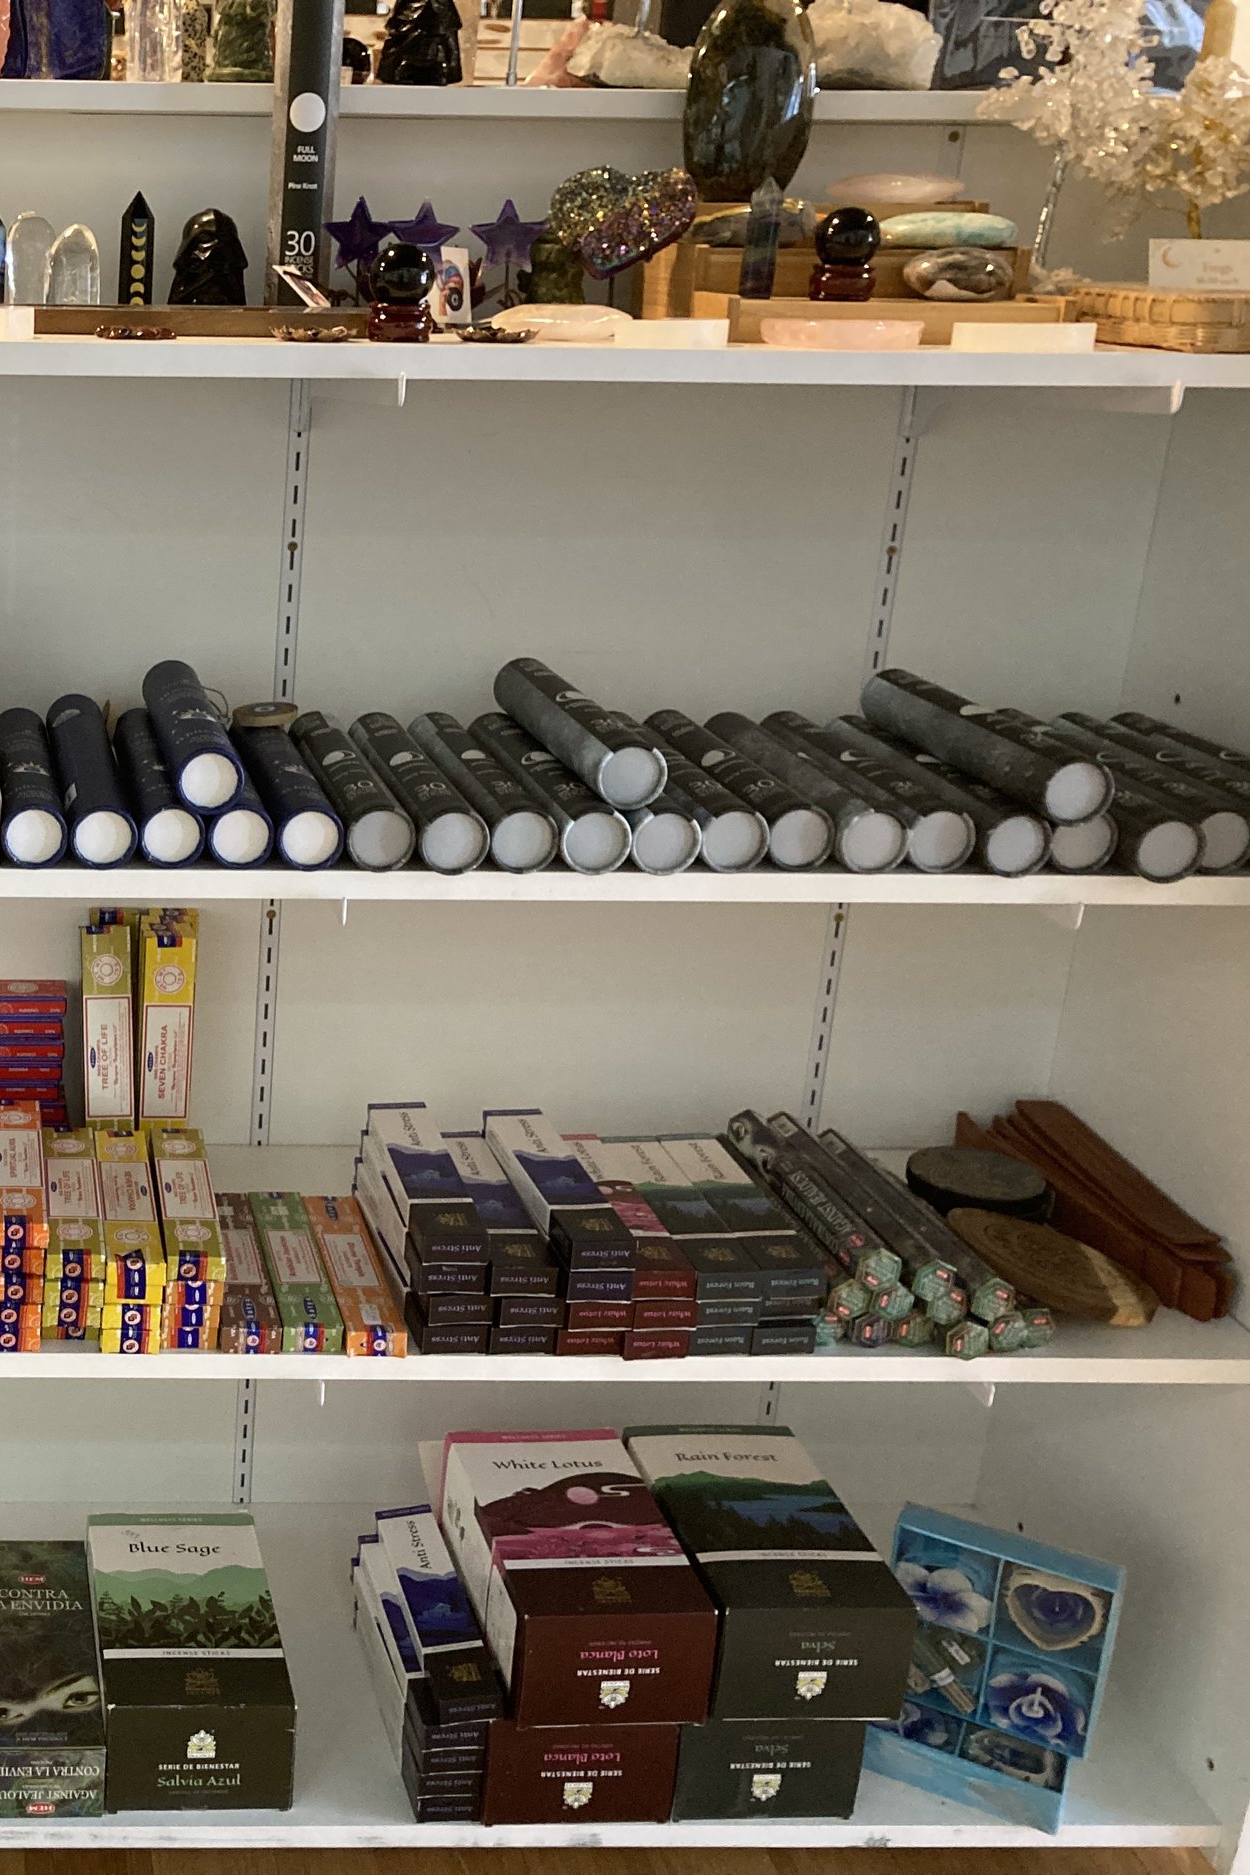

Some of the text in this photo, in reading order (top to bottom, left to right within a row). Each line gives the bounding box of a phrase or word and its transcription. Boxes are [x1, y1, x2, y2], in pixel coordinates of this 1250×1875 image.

[296, 145, 315, 154] FULL
[292, 154, 319, 163] MOON
[284, 230, 316, 256] 30
[100, 1023, 109, 1090] TREE OF LIFE
[158, 1024, 168, 1100] SEVEN CHAKRA
[431, 1244, 483, 1253] Anti Stress
[580, 1249, 631, 1258] Anti Stress
[576, 1281, 627, 1290] Anti Stress
[639, 1279, 688, 1288] White Lotus
[674, 1451, 779, 1463] Rain Forest
[493, 1458, 603, 1471] White Lotus
[128, 1541, 222, 1557] Blue Sage
[406, 1520, 432, 1570] Anti Stress
[19, 1575, 45, 1583] HEM
[10, 1599, 84, 1611] ENVIDIA
[801, 1640, 837, 1653] Selva
[162, 1649, 231, 1657] INCENSE STICKS
[580, 1649, 659, 1663] Loto Blanca
[576, 1666, 660, 1677] SERIE DE BIENESTAR
[543, 1752, 621, 1766] Loto Blanca
[34, 1766, 52, 1777] LA
[53, 1766, 100, 1777] CONTRA
[158, 1763, 181, 1771] SERIE
[182, 1763, 194, 1771] DE
[540, 1769, 623, 1778] SERIE DE BIENESTAR
[157, 1773, 241, 1788] Salvia Azul
[45, 1789, 98, 1800] AGAINST
